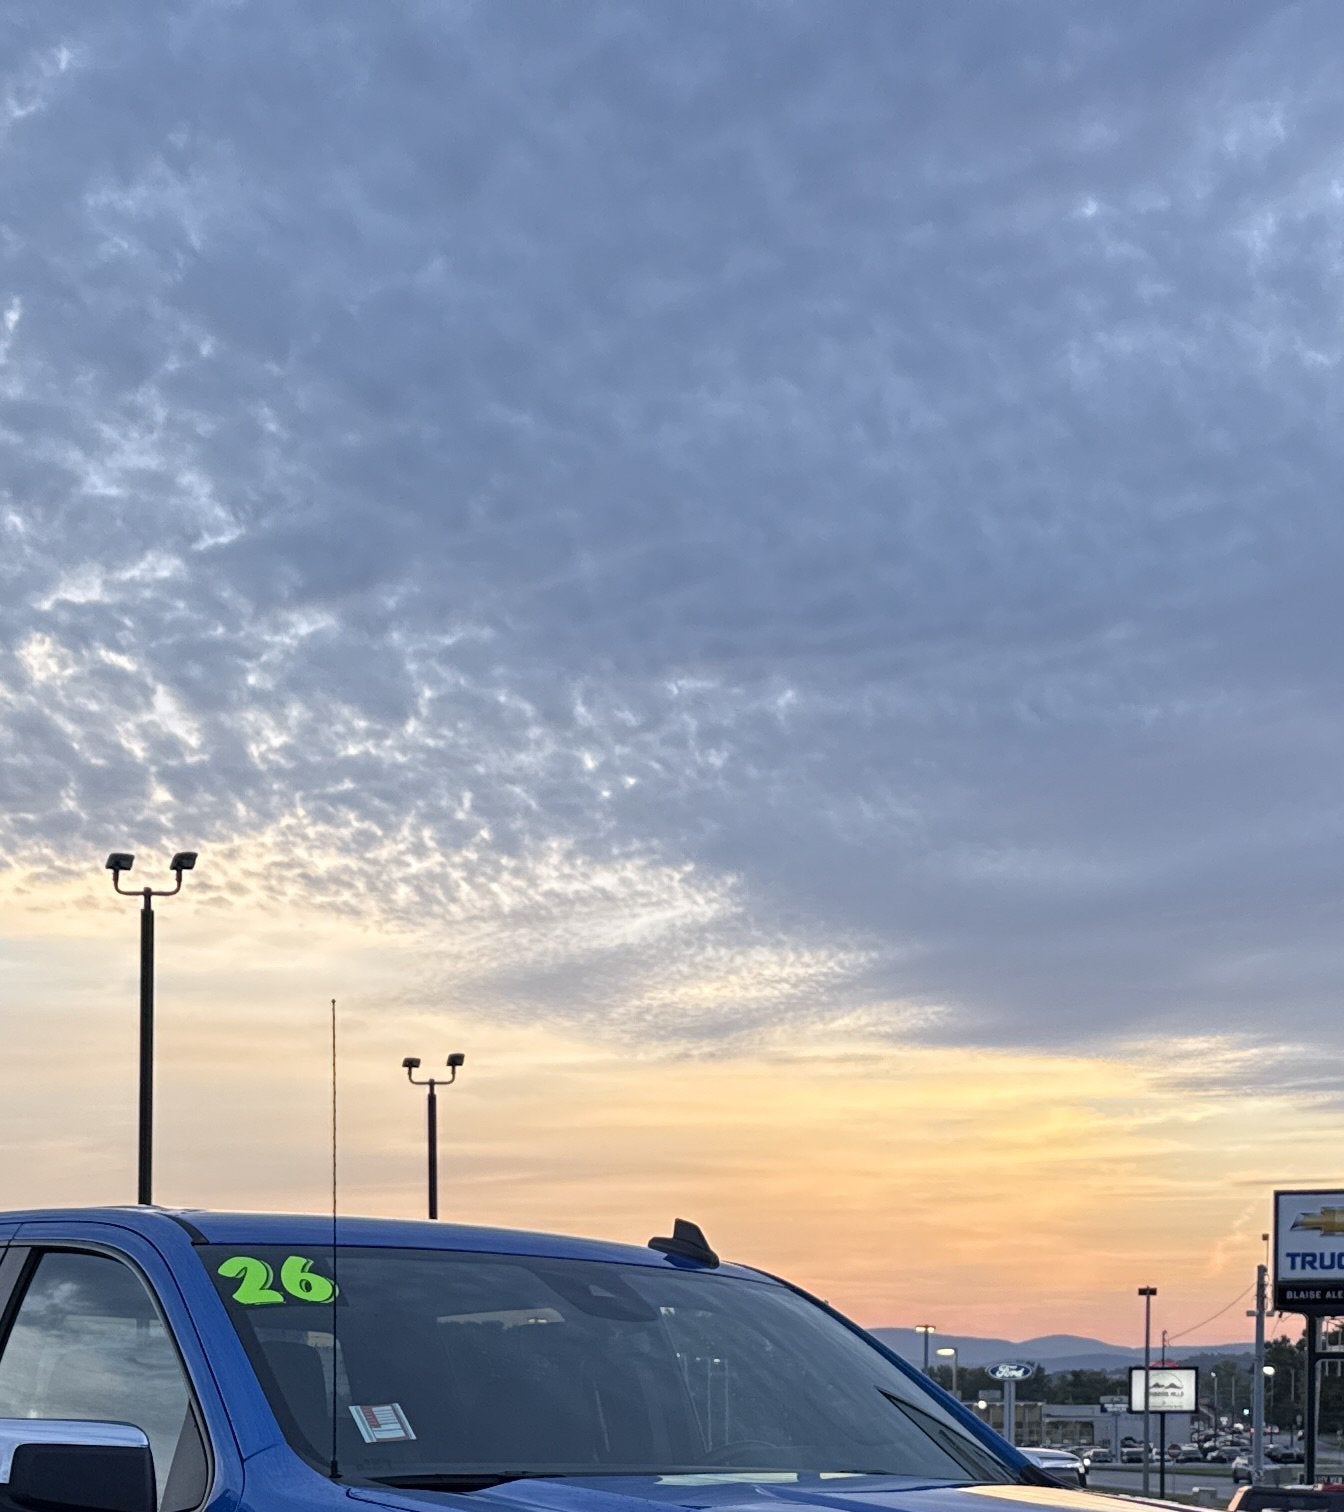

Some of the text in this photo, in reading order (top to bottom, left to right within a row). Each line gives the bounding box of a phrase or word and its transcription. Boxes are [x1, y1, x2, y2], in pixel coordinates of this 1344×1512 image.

[217, 1255, 340, 1305] 26
[1286, 1290, 1322, 1300] BLAISE
[995, 1364, 1025, 1378] Ford
